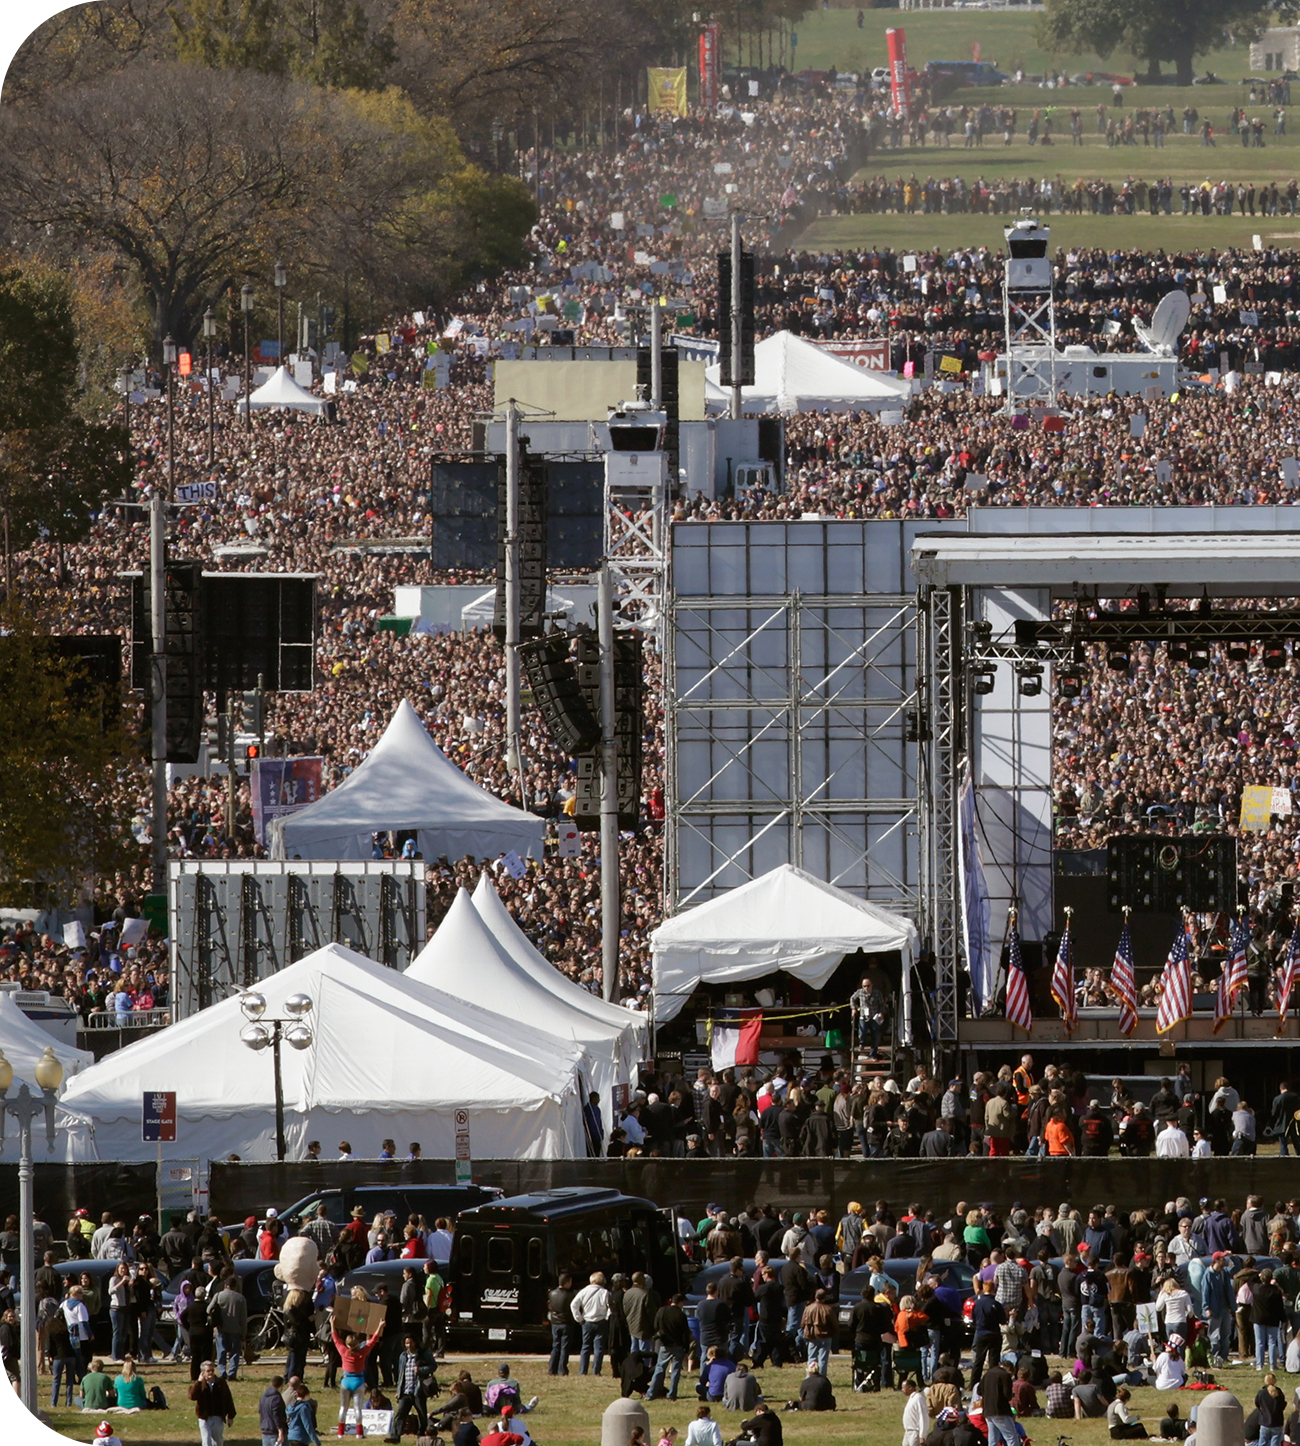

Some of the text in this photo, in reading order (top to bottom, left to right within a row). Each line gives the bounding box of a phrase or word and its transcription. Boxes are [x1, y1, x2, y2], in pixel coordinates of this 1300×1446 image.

[178, 483, 215, 500] THIS
[377, 1412, 388, 1422] R
[368, 1423, 388, 1433] OK
